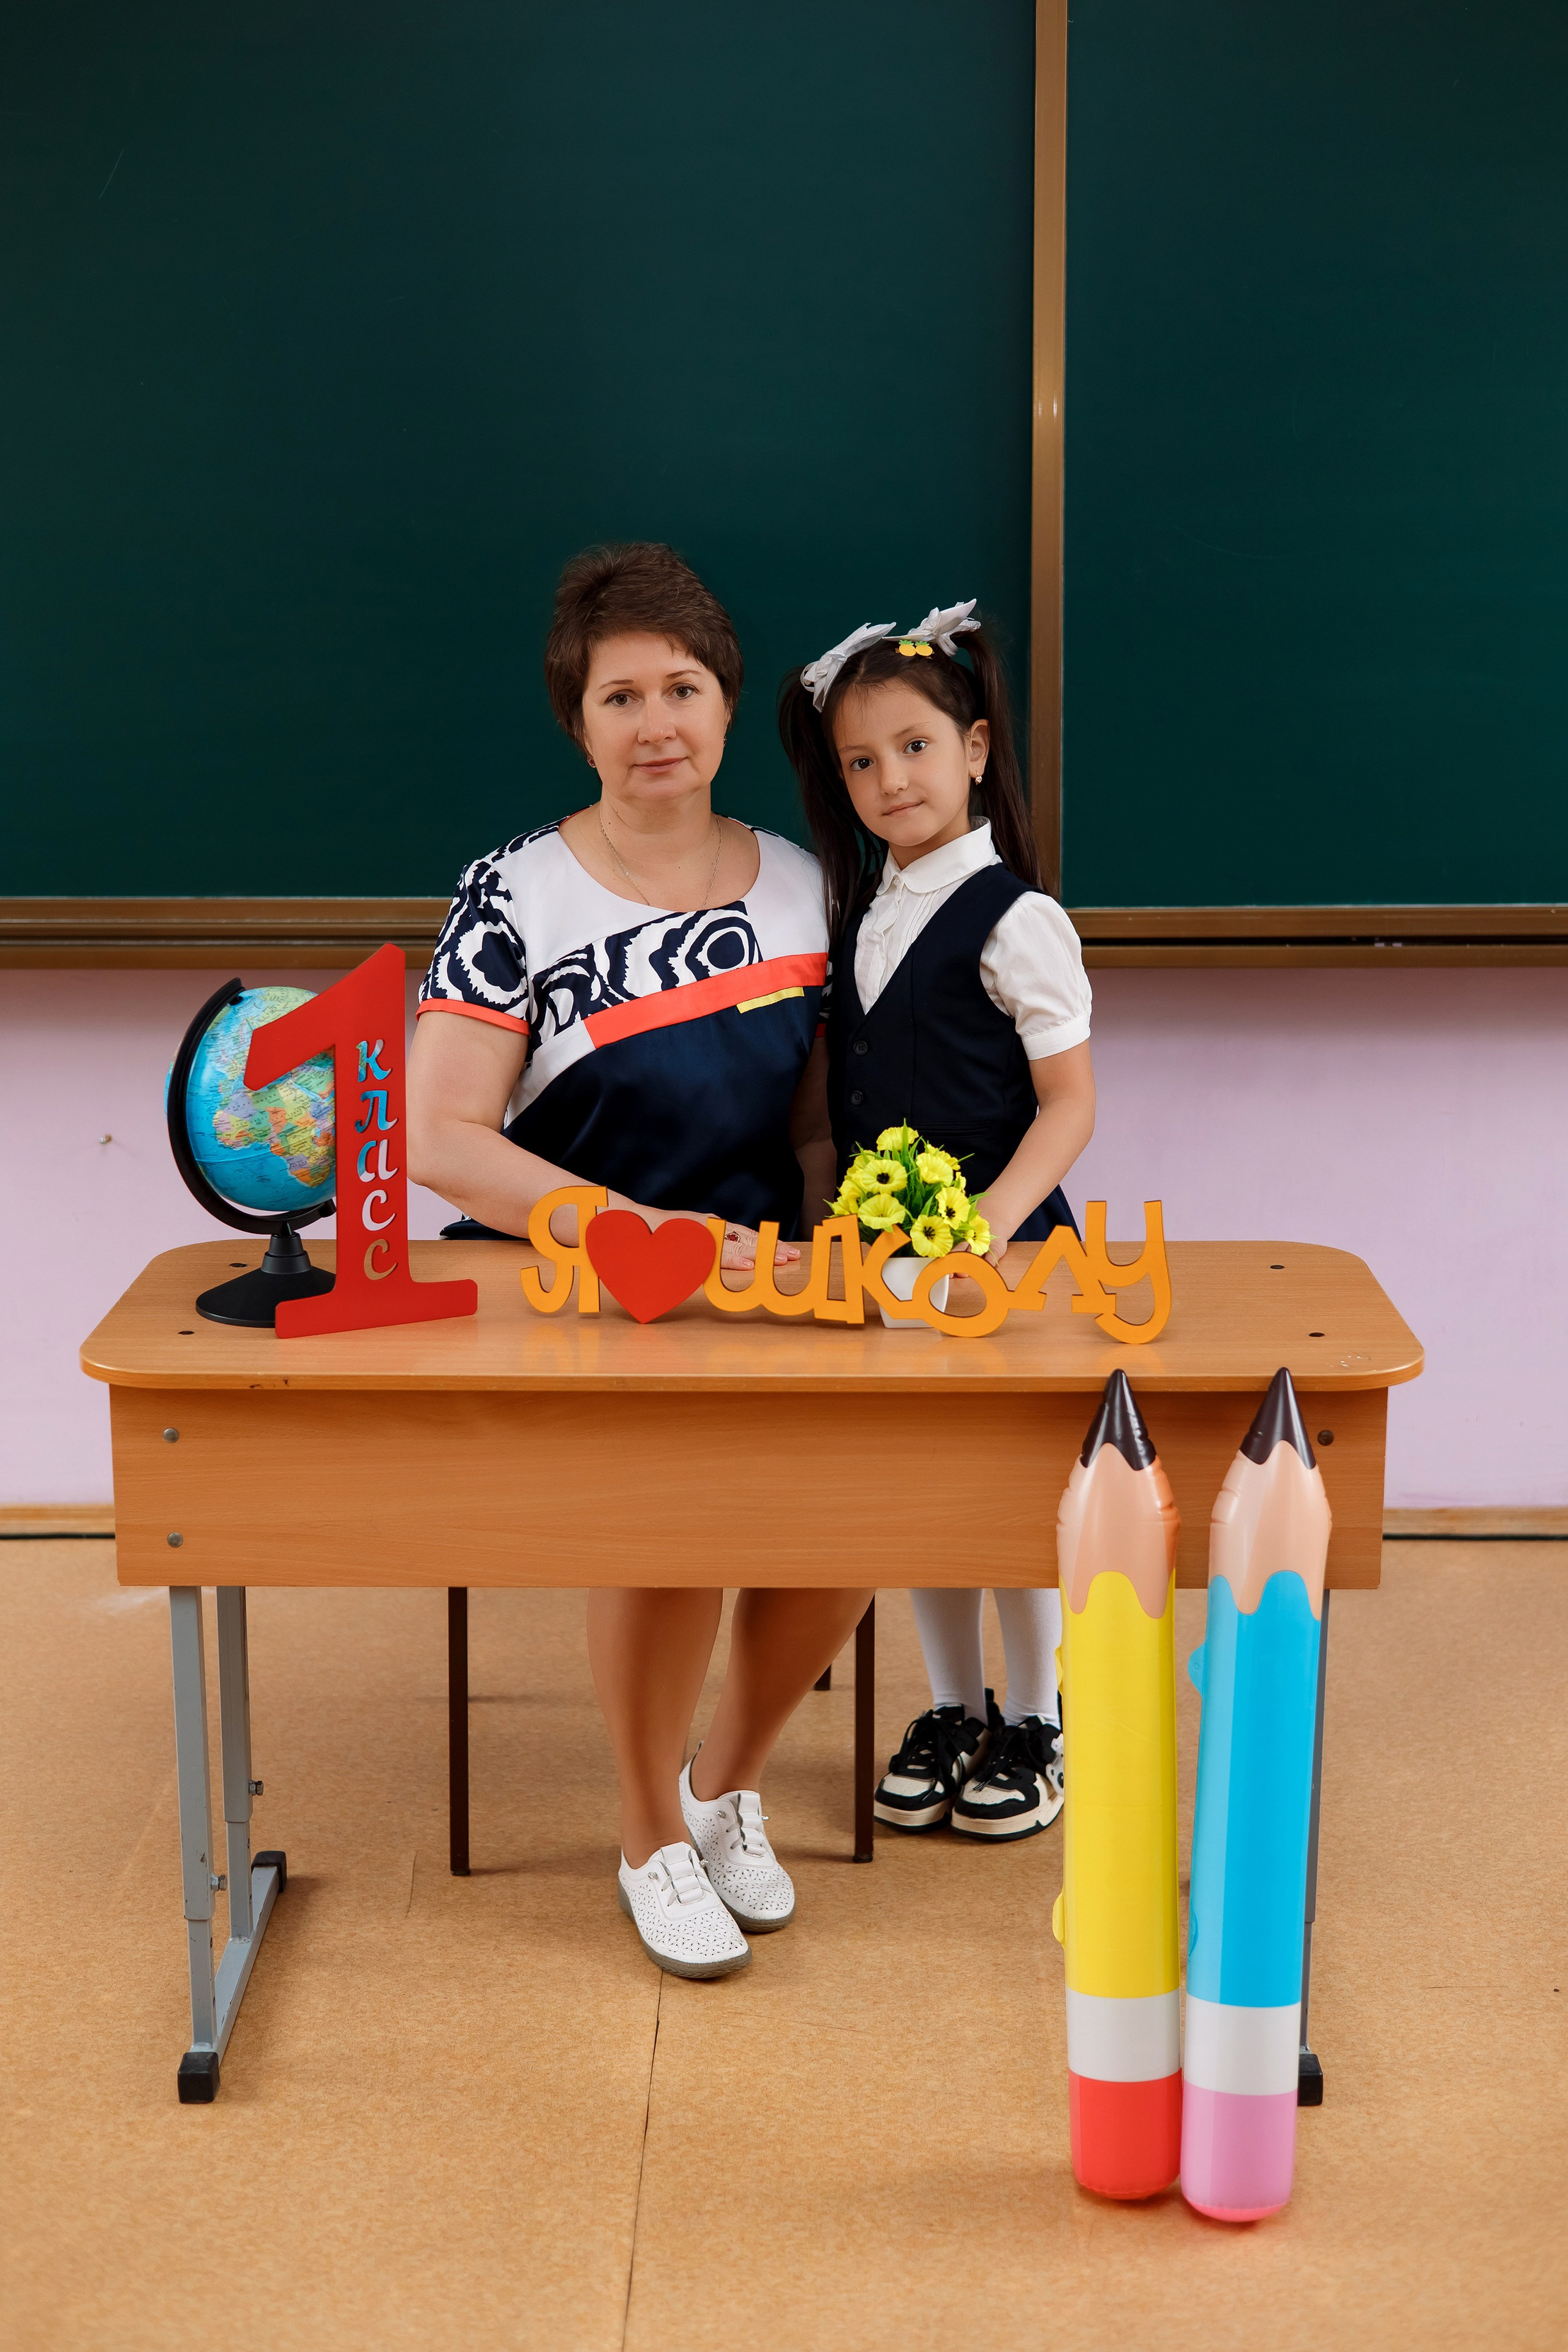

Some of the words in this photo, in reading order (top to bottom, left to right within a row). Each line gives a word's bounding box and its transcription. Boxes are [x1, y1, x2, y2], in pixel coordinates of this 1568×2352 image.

[243, 943, 478, 1339] 1
[355, 1039, 398, 1280] класс
[520, 1185, 608, 1313] Я
